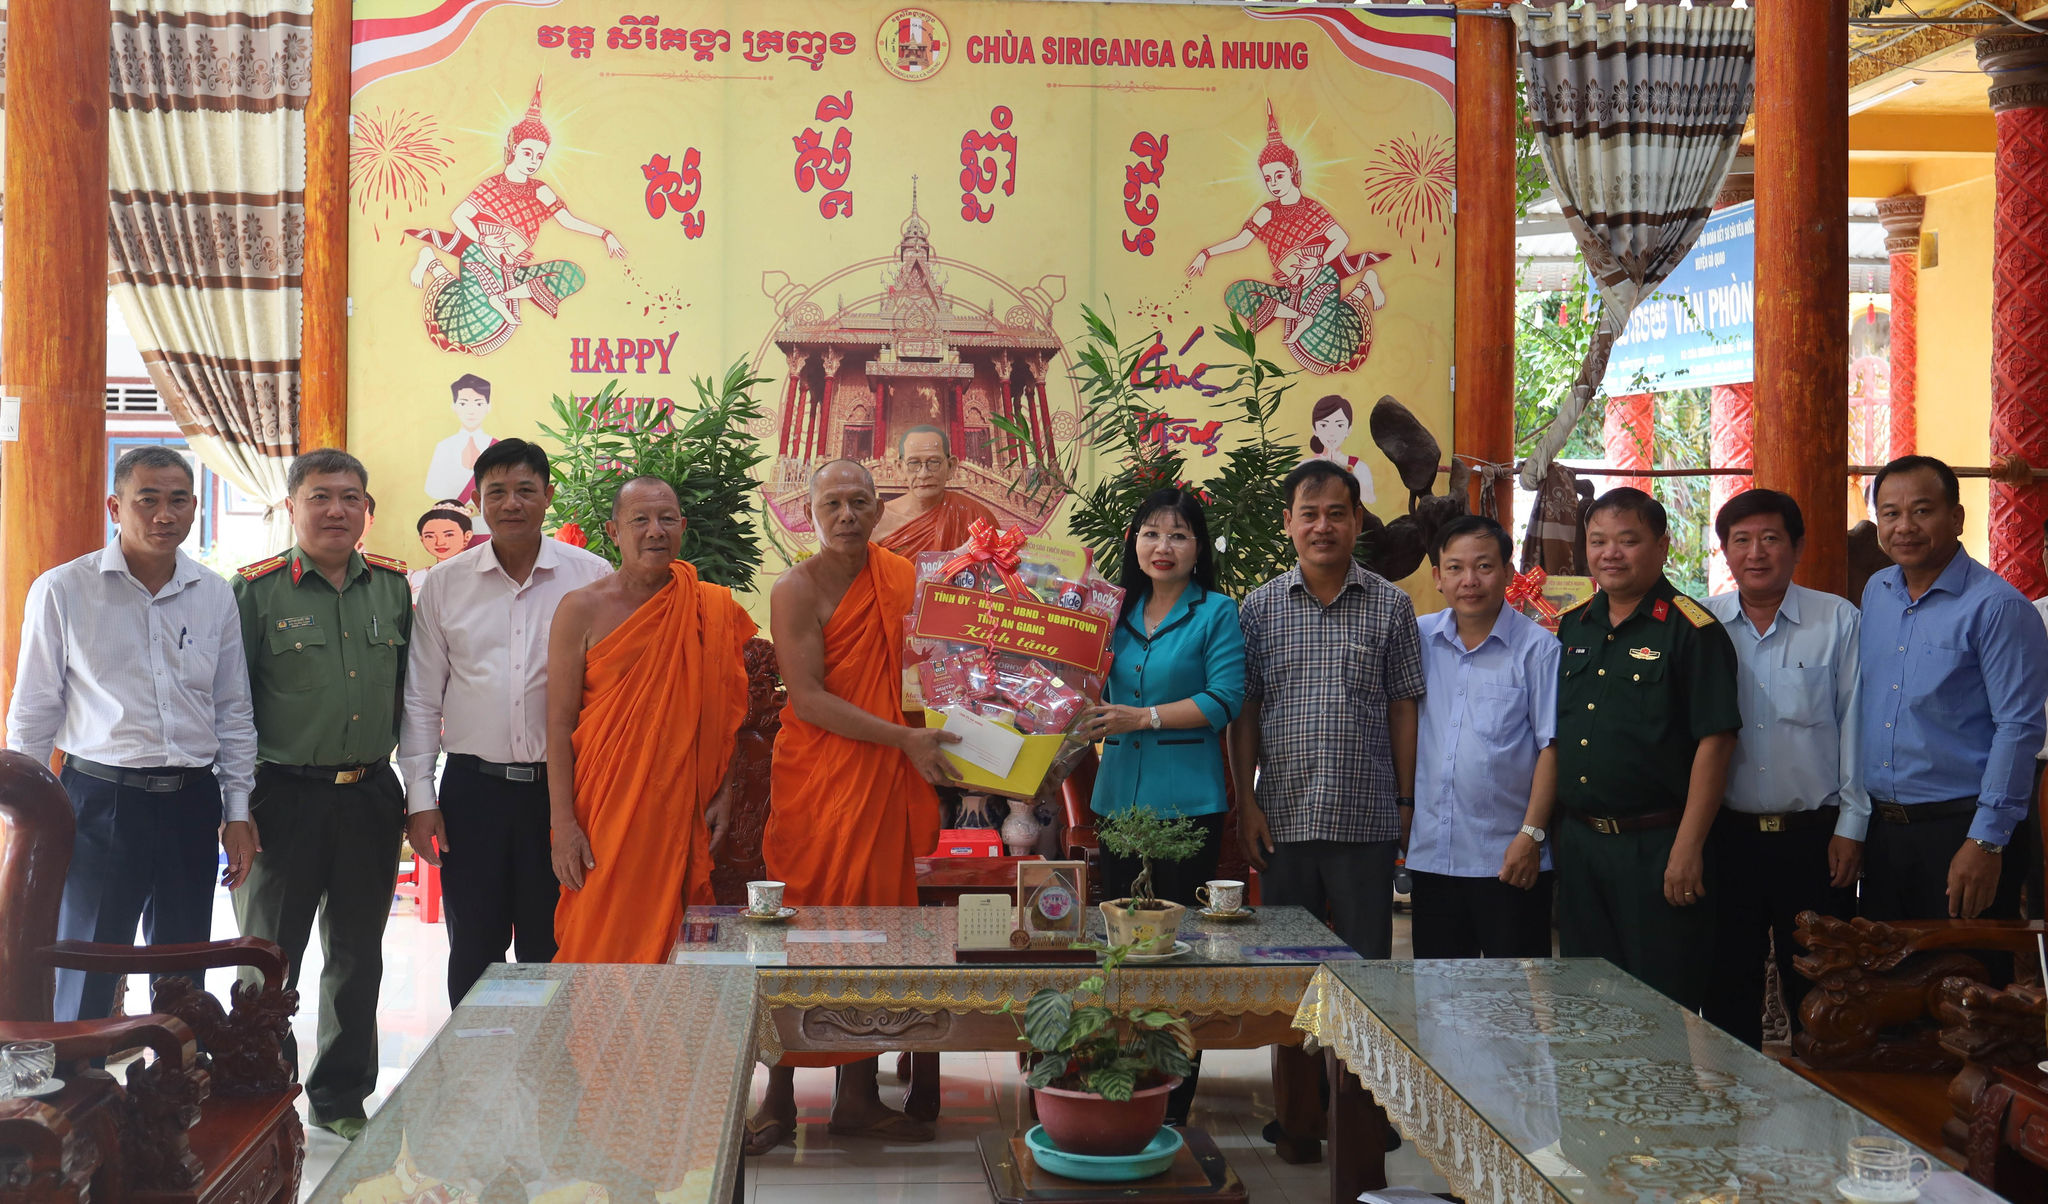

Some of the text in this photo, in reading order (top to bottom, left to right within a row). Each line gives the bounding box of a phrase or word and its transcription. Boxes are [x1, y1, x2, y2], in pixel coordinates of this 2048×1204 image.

[966, 29, 1036, 64] CHÙA
[1041, 37, 1177, 68] SIRIGANGA
[1182, 34, 1215, 69] CÀ
[1221, 41, 1309, 70] NHUNG
[1673, 285, 1706, 335] VĂN
[1708, 272, 1754, 329] PHÒN
[570, 330, 680, 374] HAPPY
[921, 560, 944, 573] POCK
[934, 590, 956, 604] TỈNH
[957, 593, 971, 605] ỦY
[1013, 606, 1039, 619] UBND
[1047, 613, 1098, 634] UBMTTQVN
[1001, 618, 1015, 629] AN
[1016, 621, 1046, 636] GIANG
[1016, 637, 1060, 656] tặng
